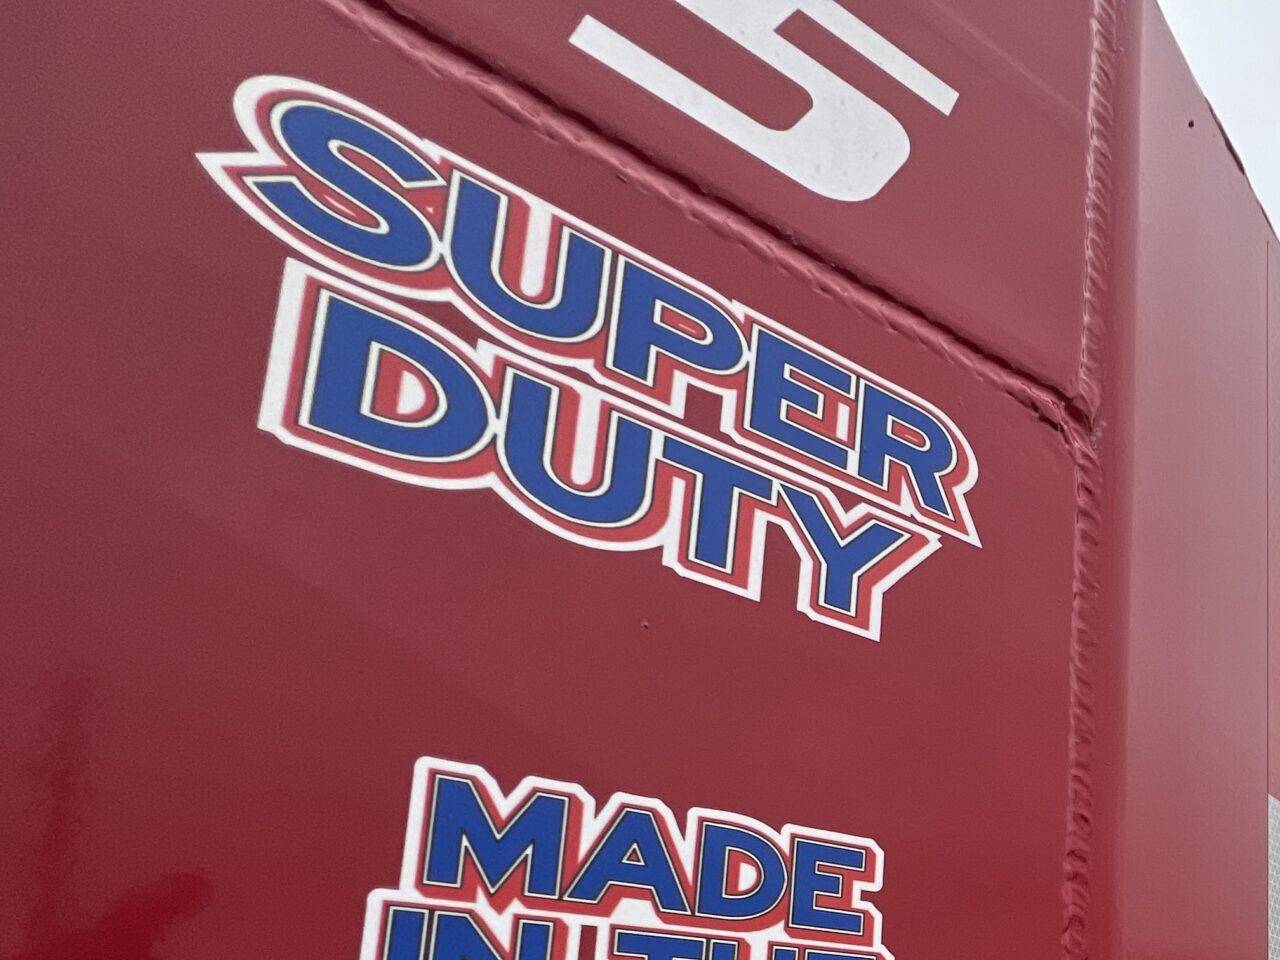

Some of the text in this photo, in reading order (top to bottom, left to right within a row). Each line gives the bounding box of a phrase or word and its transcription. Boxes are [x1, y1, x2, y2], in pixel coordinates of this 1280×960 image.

[240, 99, 961, 523] SUPER
[298, 286, 914, 620] DUTY
[420, 773, 875, 939] MADE
